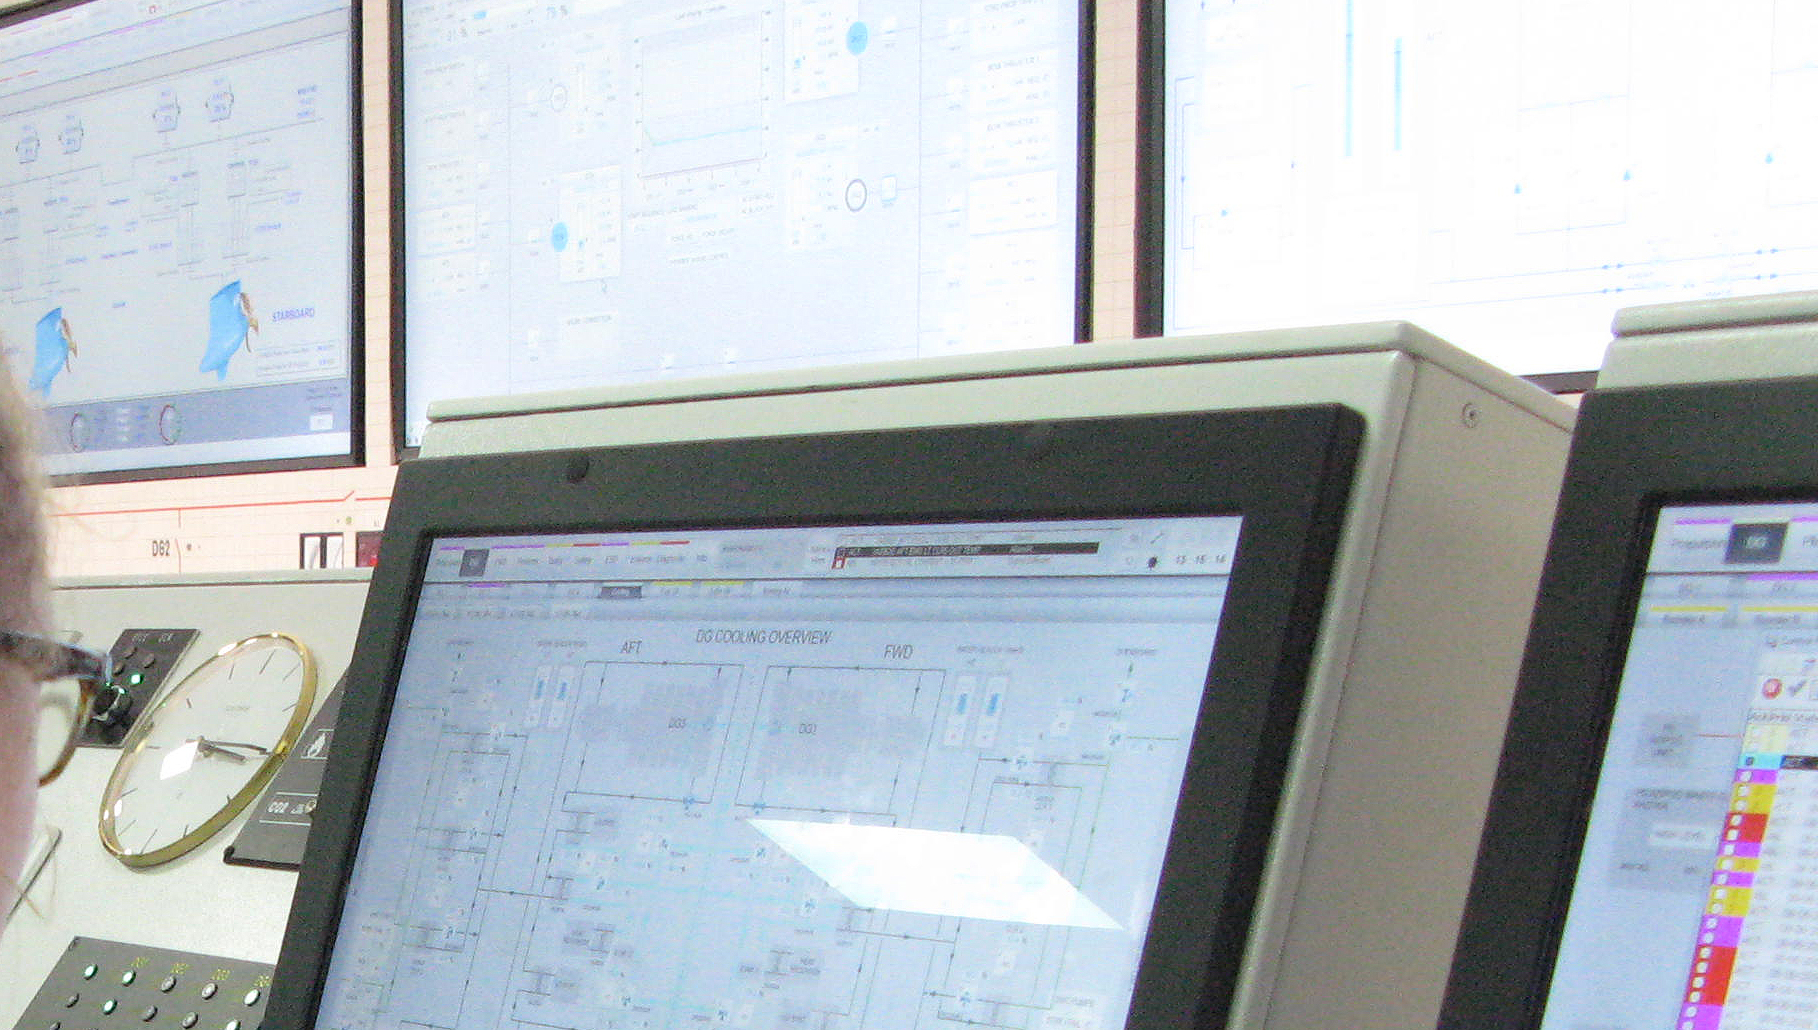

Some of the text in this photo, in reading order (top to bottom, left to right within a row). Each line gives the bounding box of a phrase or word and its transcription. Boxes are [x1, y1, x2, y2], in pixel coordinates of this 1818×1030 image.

[696, 627, 833, 646] DG COOLING OVERVIEW
[619, 640, 643, 654] AFT
[884, 644, 914, 659] FWD
